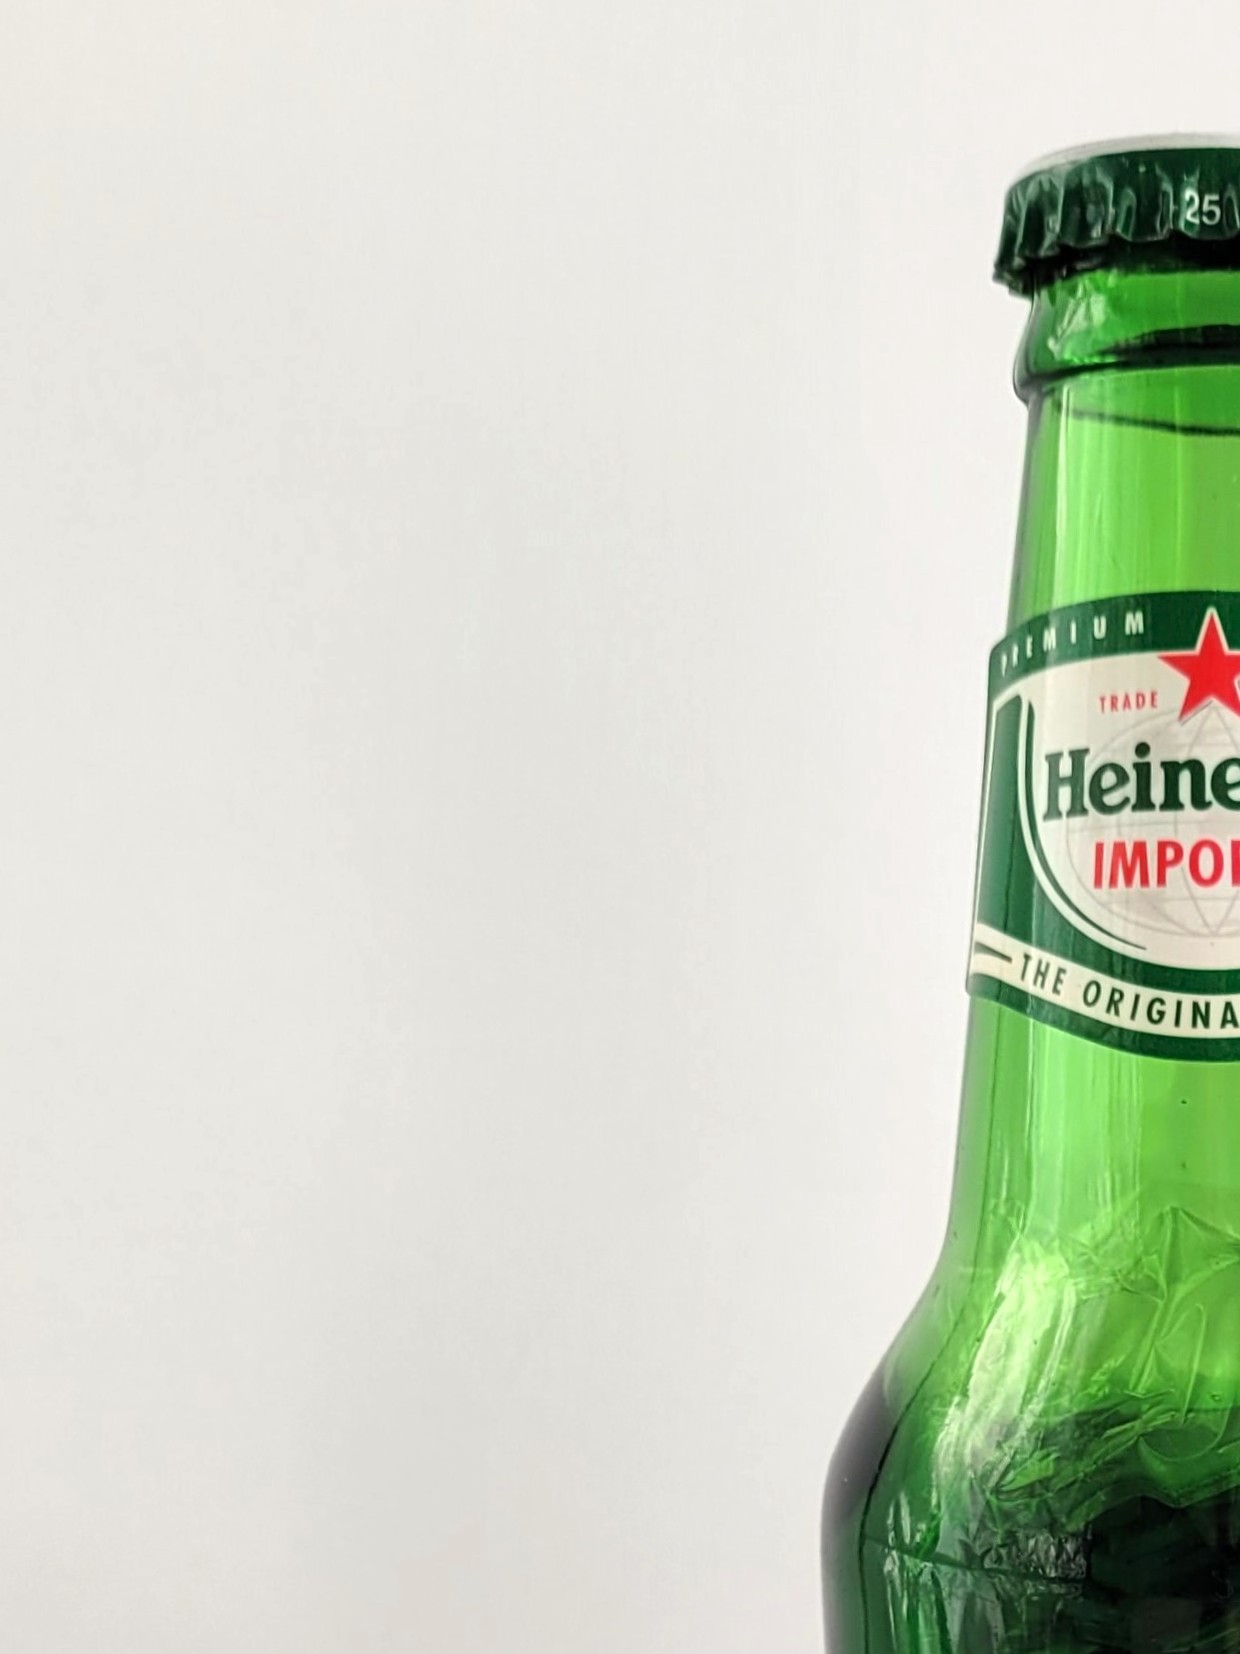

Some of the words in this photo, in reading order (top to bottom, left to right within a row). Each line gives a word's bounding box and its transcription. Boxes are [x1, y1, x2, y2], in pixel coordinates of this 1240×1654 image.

[1185, 188, 1221, 226] 25
[1001, 610, 1144, 677] PREMIUM
[1099, 690, 1158, 714] TRADE
[1018, 951, 1064, 996] THE
